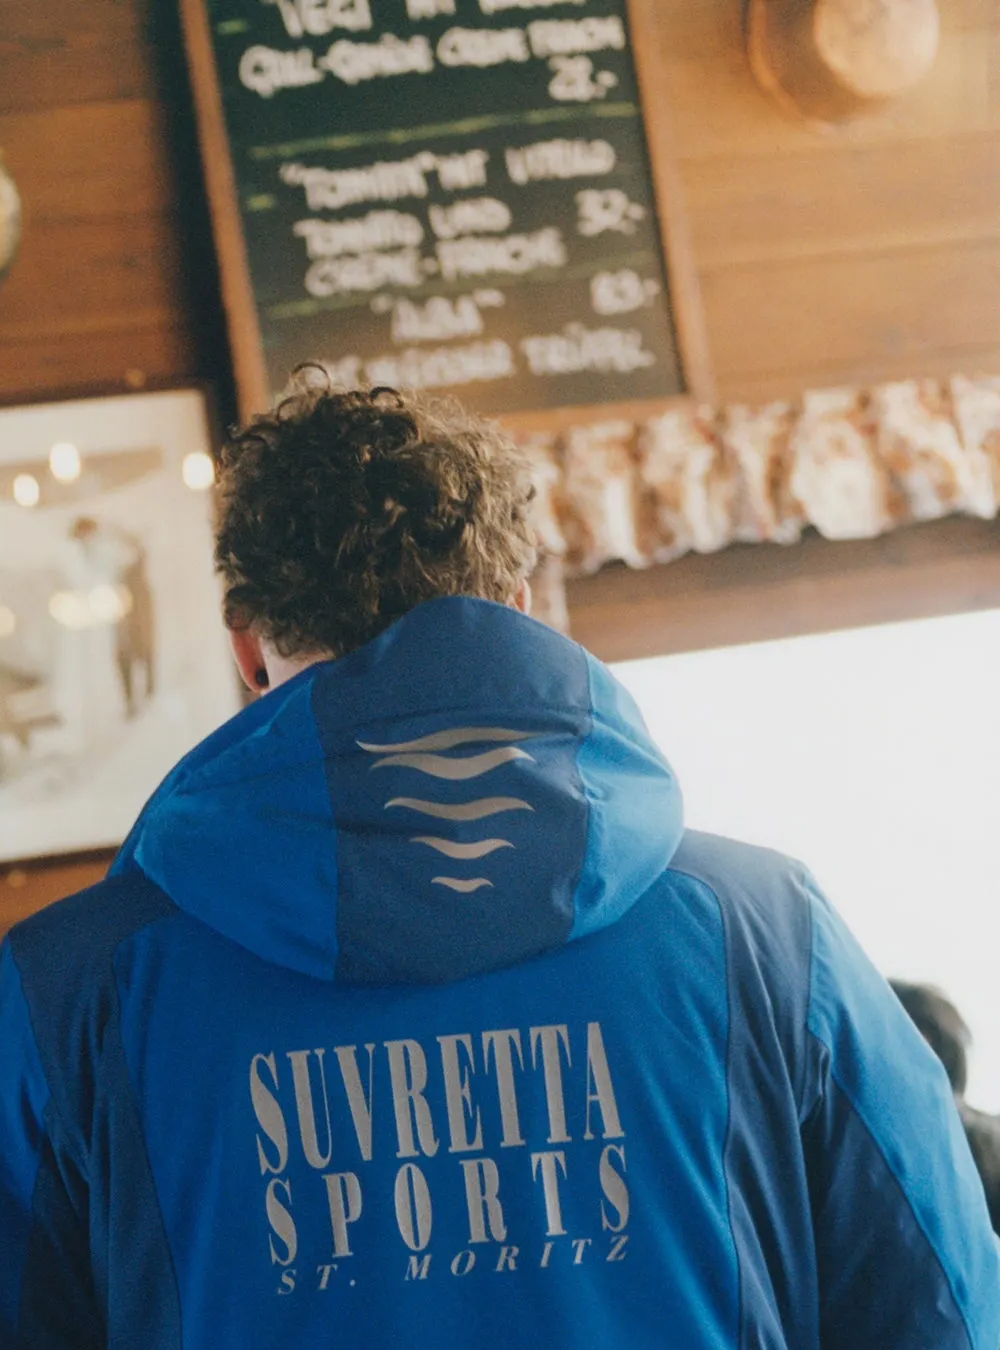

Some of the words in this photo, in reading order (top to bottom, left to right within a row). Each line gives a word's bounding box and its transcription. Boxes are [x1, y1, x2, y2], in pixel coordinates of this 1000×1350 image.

[249, 1022, 625, 1175] SUVRETTA
[265, 1143, 630, 1267] SPORTS
[277, 1263, 356, 1295] ST.
[405, 1235, 630, 1282] MORITZ
